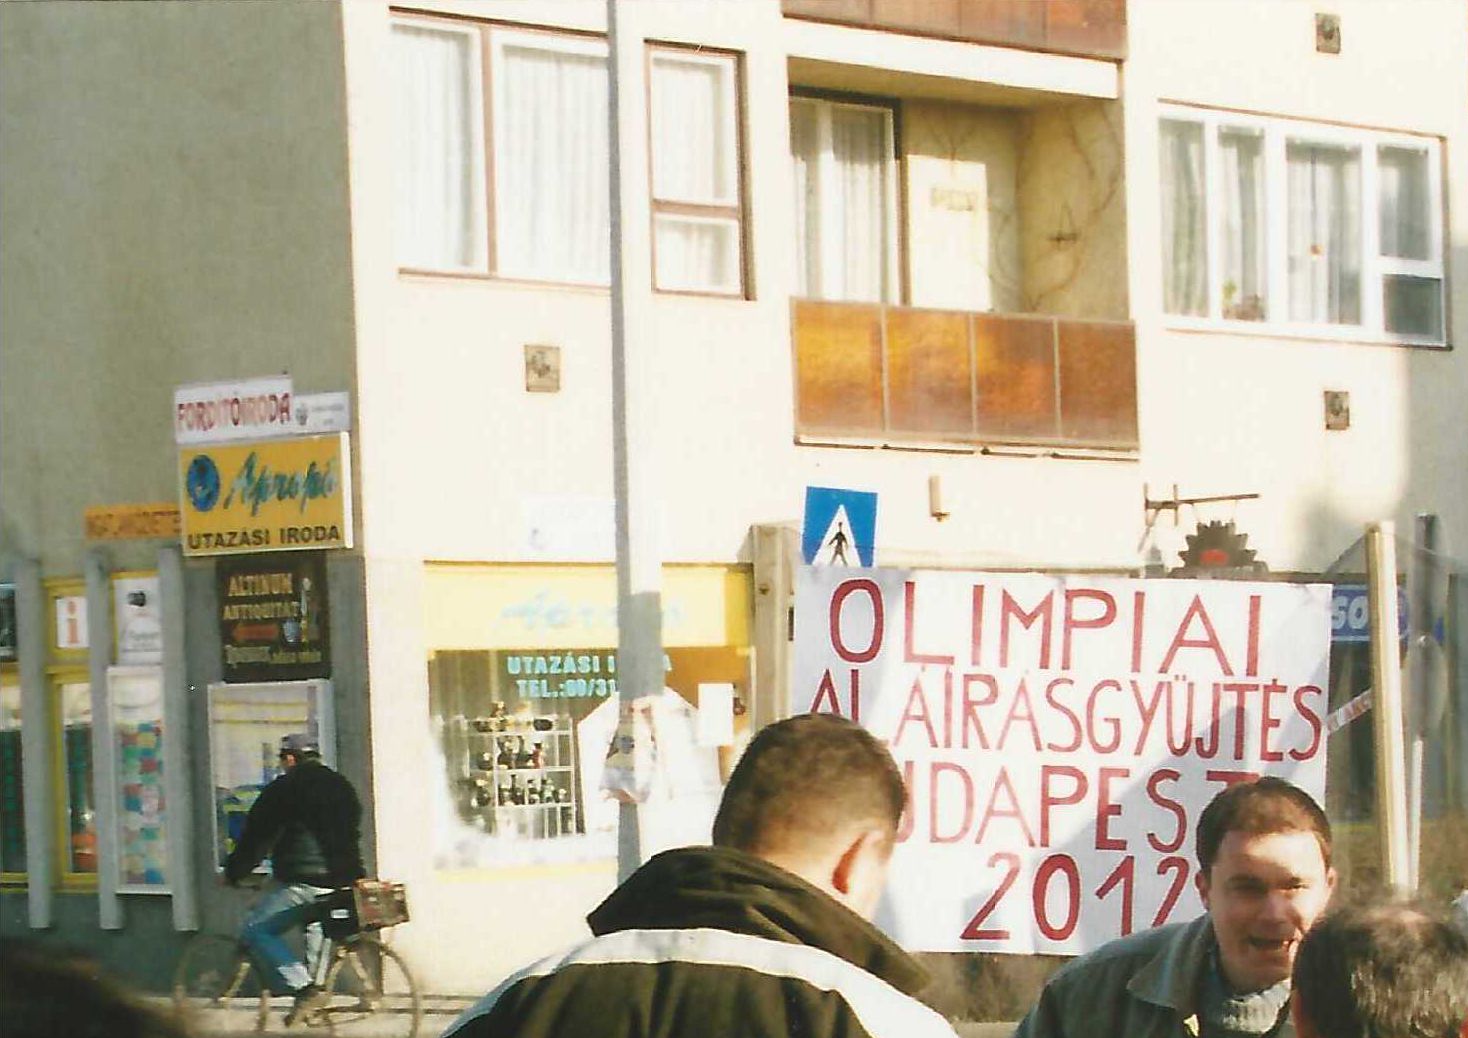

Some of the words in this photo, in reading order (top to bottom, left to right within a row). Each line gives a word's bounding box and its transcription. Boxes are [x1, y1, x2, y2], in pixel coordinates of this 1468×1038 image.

[280, 525, 340, 546] IRODA
[507, 652, 600, 675] UTAZÁSI
[829, 578, 1262, 677] OLIMPIAI
[895, 760, 1259, 853] UDAPES
[960, 852, 1190, 941] 2012
